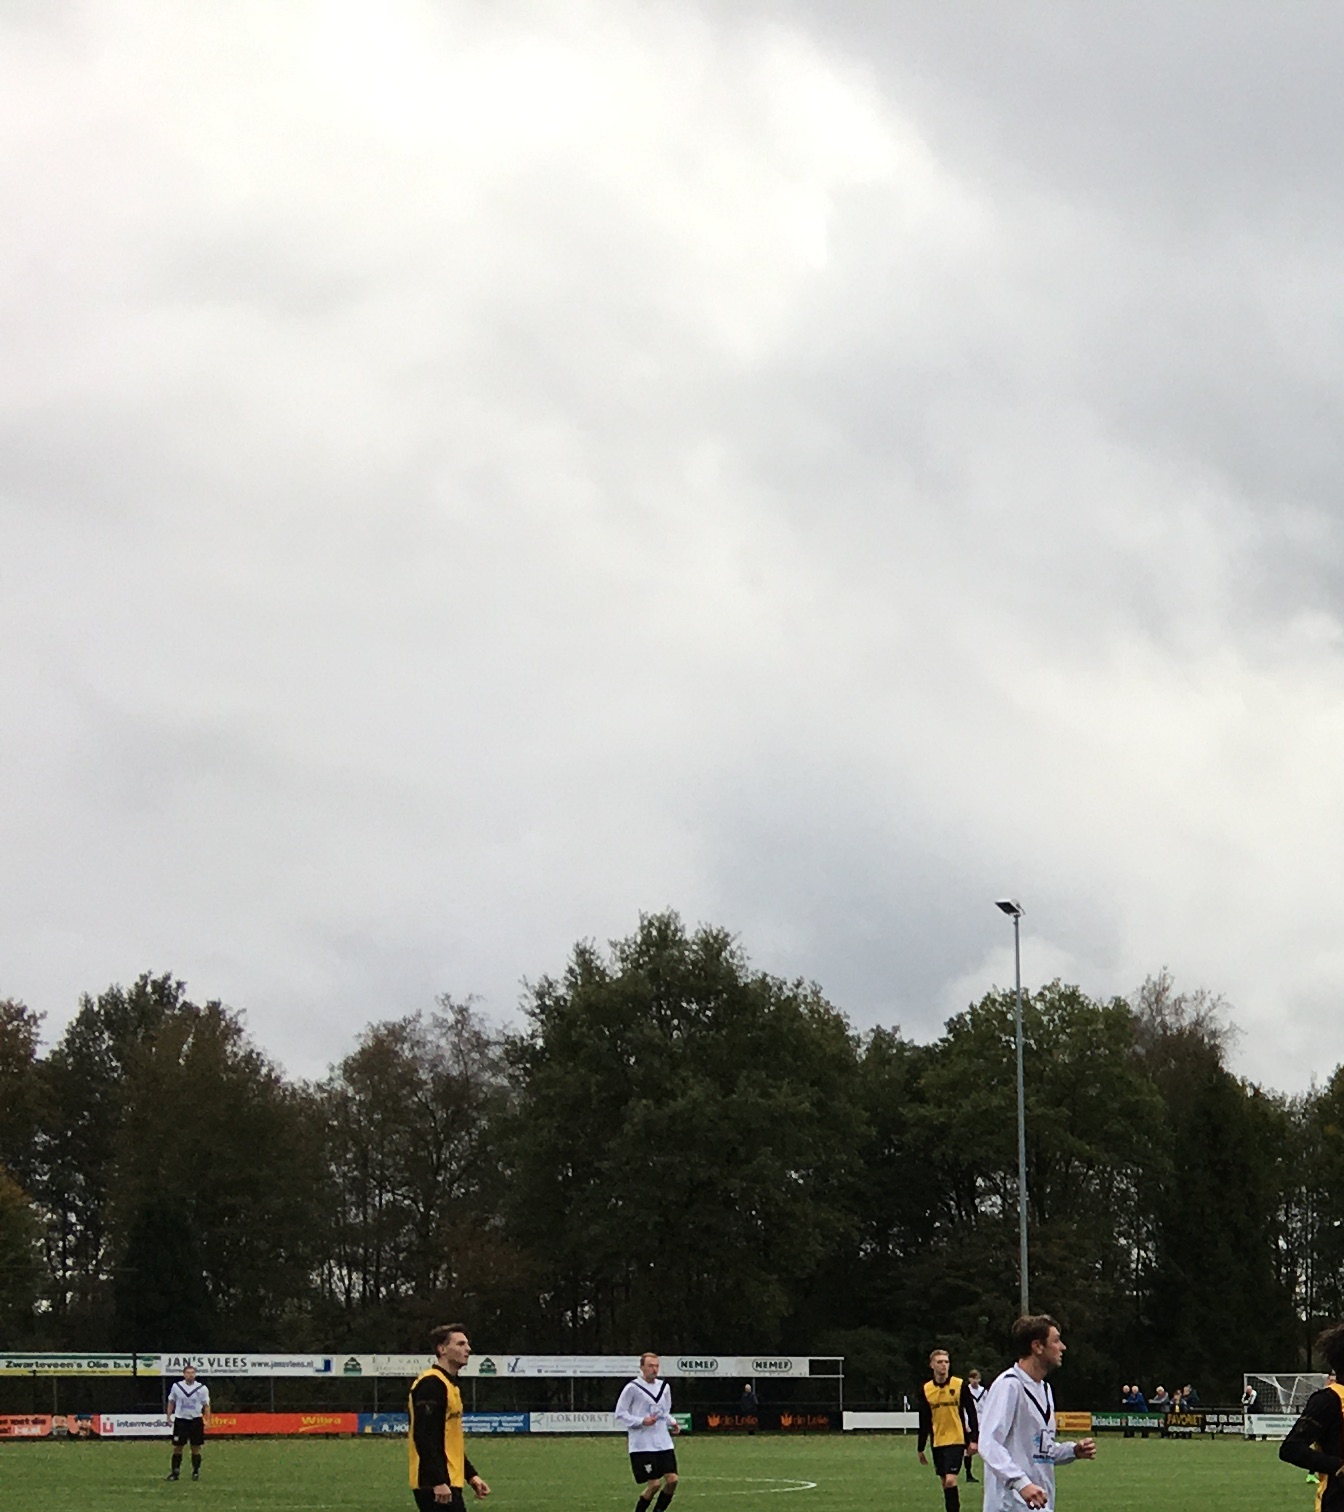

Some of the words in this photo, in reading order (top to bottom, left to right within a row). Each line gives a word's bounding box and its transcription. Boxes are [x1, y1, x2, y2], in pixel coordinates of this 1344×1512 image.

[5, 1360, 83, 1369] Zwarteveen's
[166, 1356, 205, 1368] JAN'S
[207, 1356, 248, 1368] VLEES
[681, 1360, 716, 1369] NEMEF
[755, 1361, 789, 1370] NEMEF
[301, 1415, 342, 1425] Wibra
[550, 1413, 609, 1423] LOKHORST
